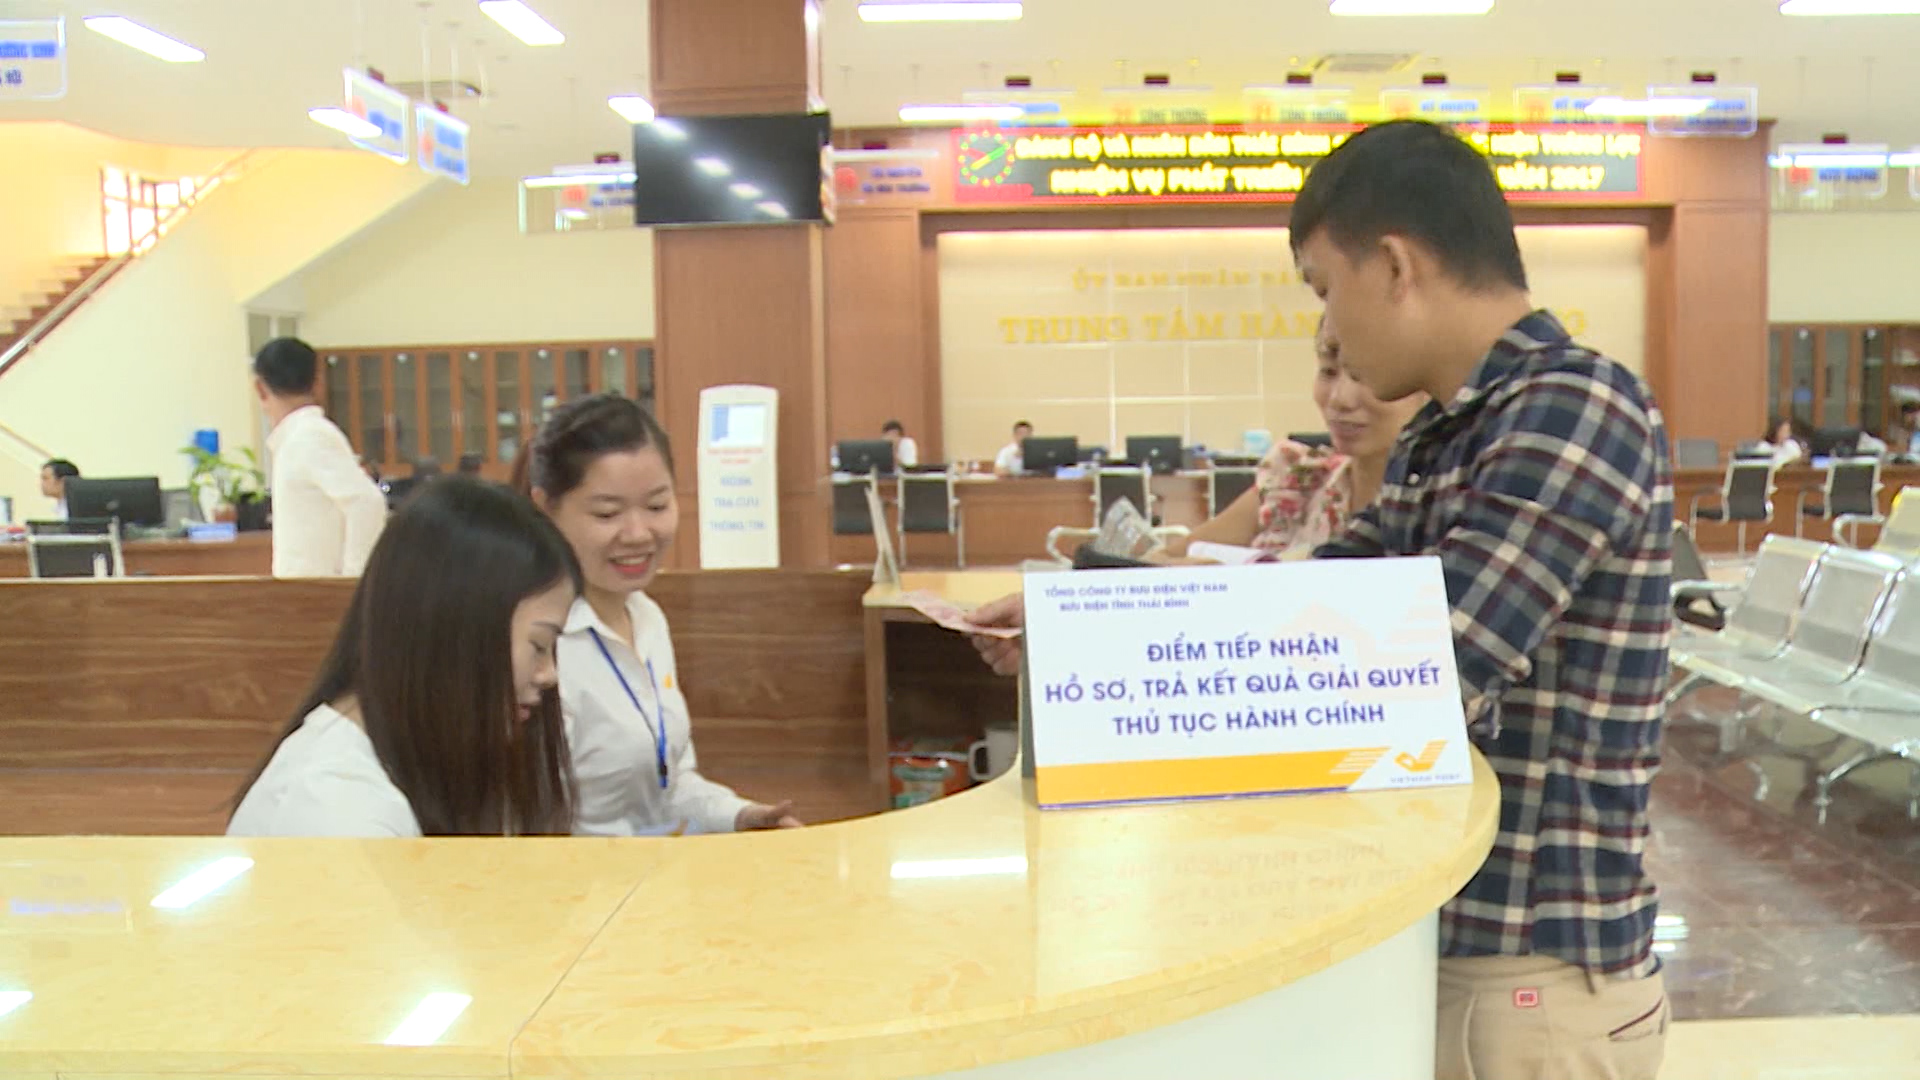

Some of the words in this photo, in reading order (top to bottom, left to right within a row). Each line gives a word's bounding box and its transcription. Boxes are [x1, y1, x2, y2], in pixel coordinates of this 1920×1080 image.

[998, 314, 1129, 342] TRUNG
[1078, 585, 1112, 597] CÔNG
[1202, 583, 1228, 593] NAM
[1146, 631, 1207, 663] ĐIỂM
[1213, 631, 1262, 660] TIẾP
[1269, 632, 1340, 662] NHẬN
[1045, 672, 1084, 704] HỒ
[1092, 677, 1135, 703] SƠ,
[1141, 670, 1189, 698] TRẢ
[1197, 667, 1238, 697] KẾT
[1245, 665, 1301, 694] QUẢ
[1308, 663, 1360, 691] GIẢI
[1367, 658, 1442, 689] QUYẾT
[1111, 707, 1161, 736] THỦ
[1168, 712, 1218, 738] TỤC
[1225, 705, 1298, 731] HÀNH
[1304, 700, 1386, 727] CHÍNH
